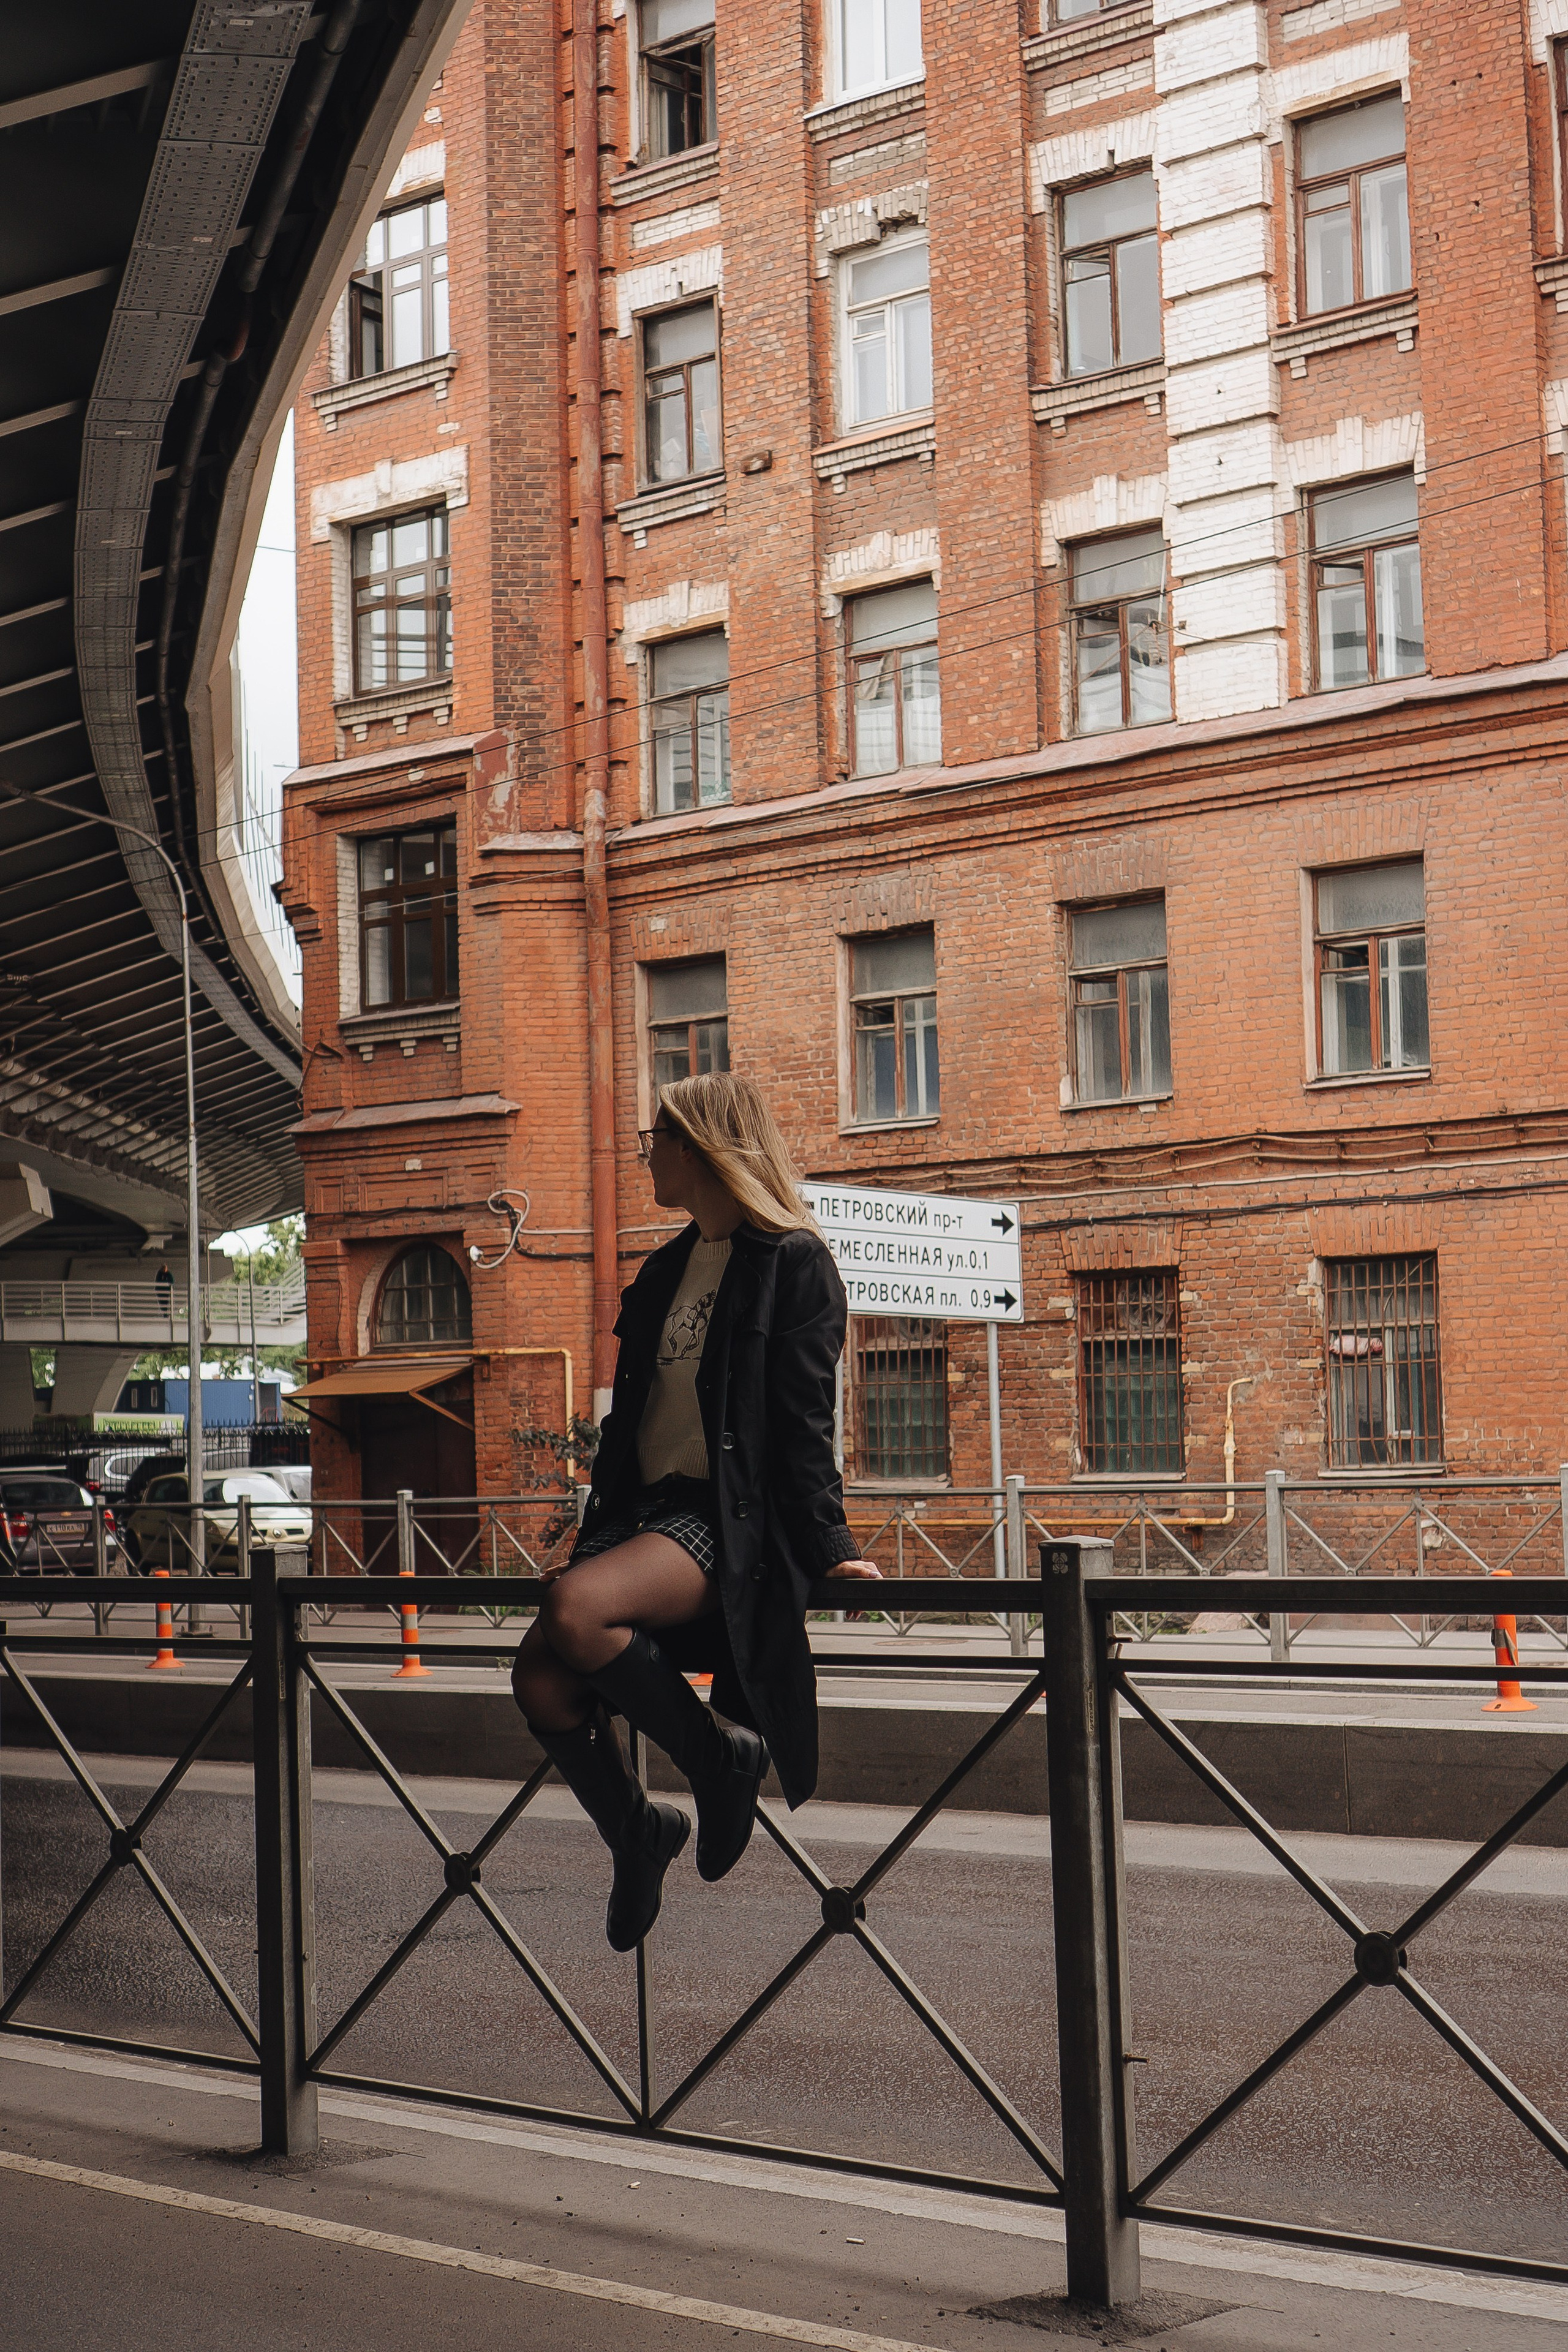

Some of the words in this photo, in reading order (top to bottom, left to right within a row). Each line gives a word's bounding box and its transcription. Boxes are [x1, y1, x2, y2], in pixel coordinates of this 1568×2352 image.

[820, 1197, 927, 1226] ПЕТРОВСКИЙ
[934, 1213, 963, 1232] пр-т
[829, 1238, 942, 1266] ЕМЕСЛЕННАЯ
[847, 1281, 934, 1305] ТРОВСКАЯ
[940, 1292, 962, 1306] пл.
[970, 1289, 991, 1309] 0,9
